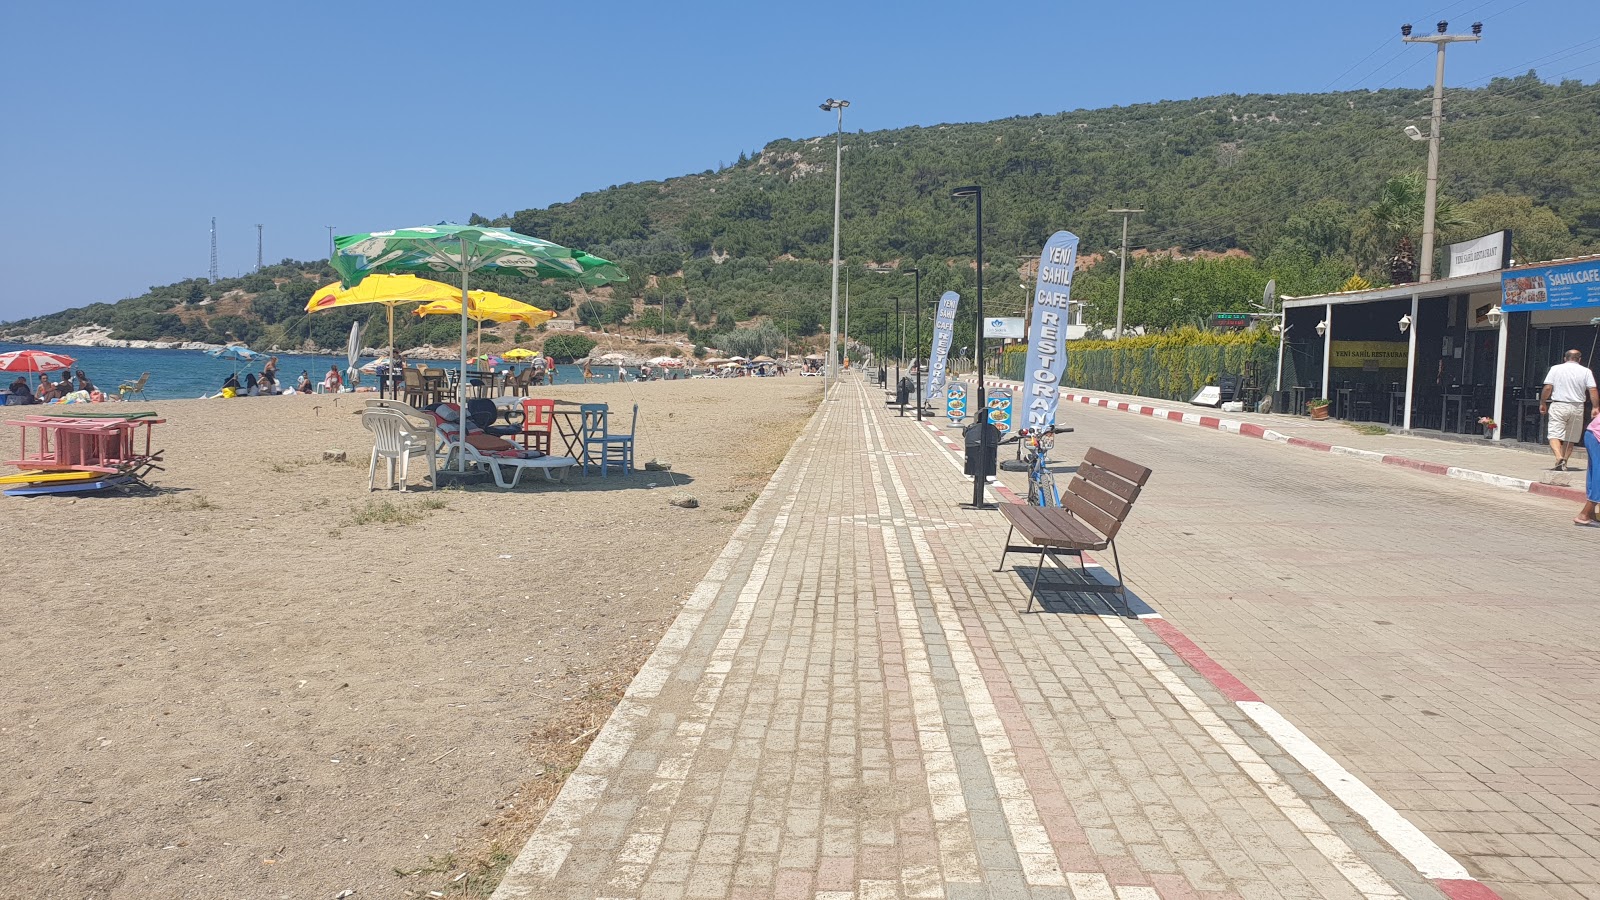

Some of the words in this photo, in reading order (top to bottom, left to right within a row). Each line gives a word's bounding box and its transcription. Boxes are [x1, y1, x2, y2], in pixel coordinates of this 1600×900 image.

[1049, 246, 1072, 265] YENİ
[1042, 265, 1070, 287] SAHİL
[1037, 289, 1068, 310] CAFE
[1351, 350, 1370, 358] SAHİL
